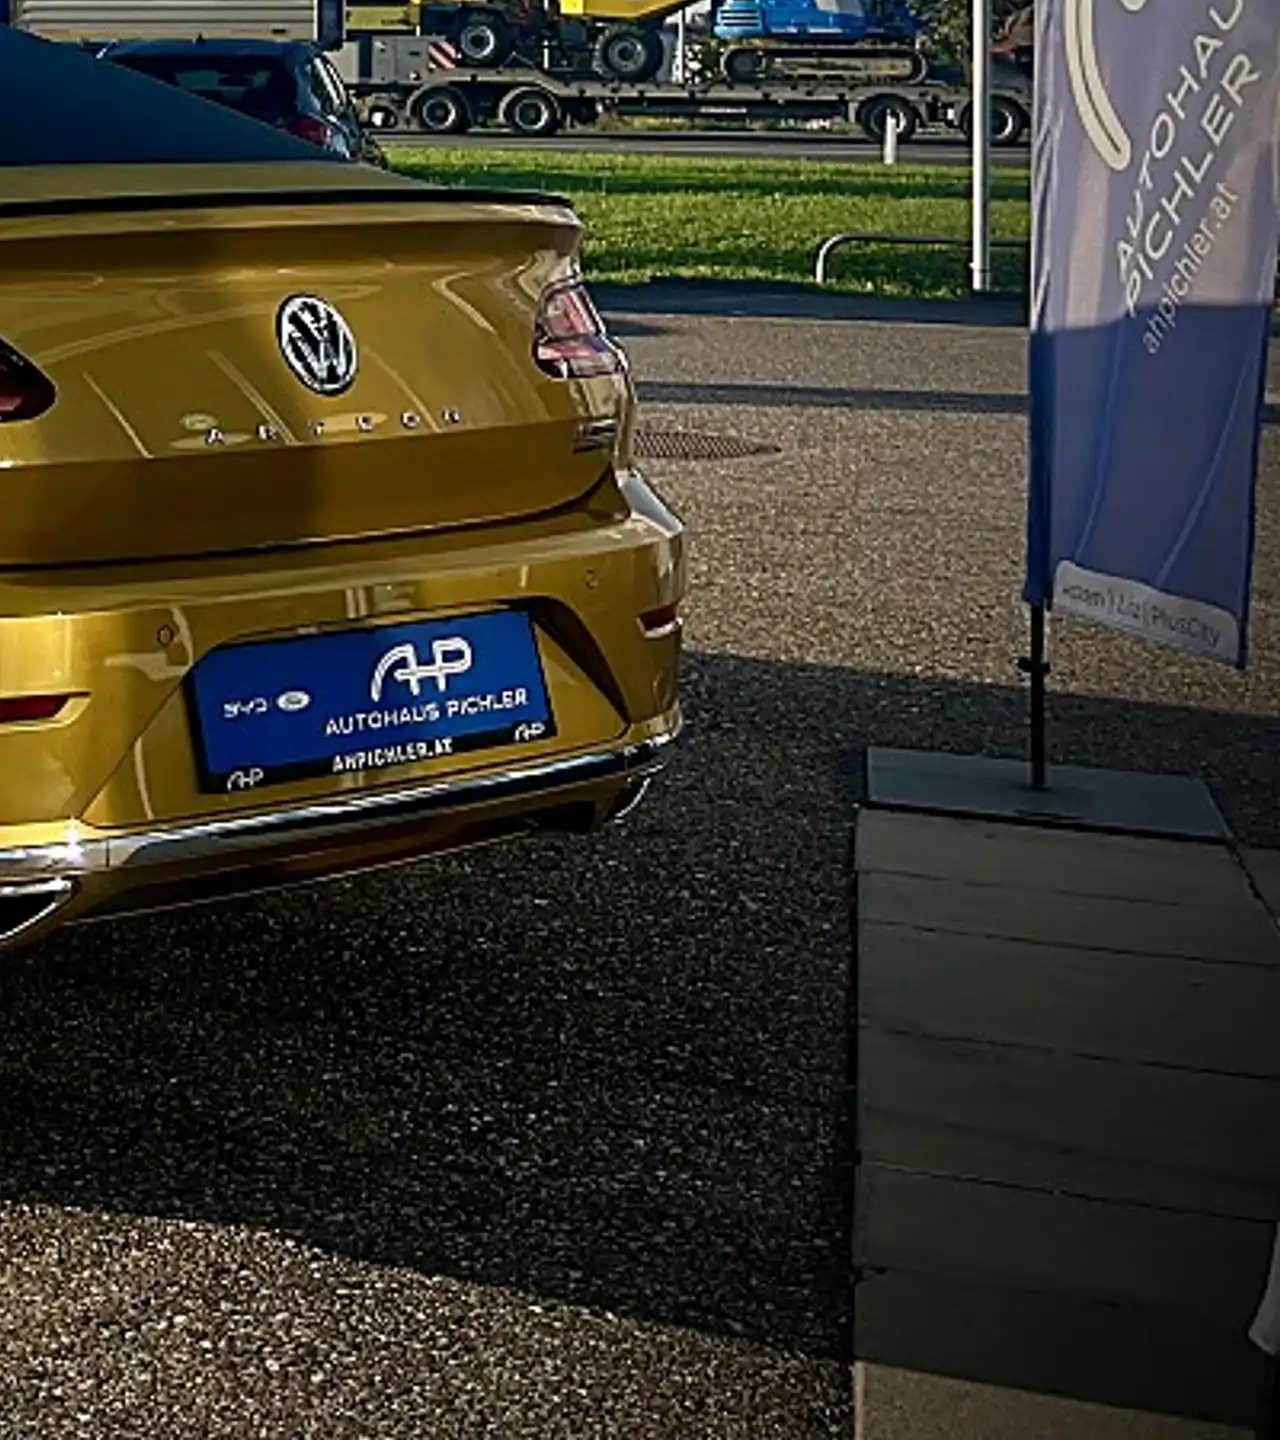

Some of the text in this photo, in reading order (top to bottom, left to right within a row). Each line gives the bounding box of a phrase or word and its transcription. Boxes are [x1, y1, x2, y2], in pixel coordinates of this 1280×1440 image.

[1124, 53, 1260, 318] PICHLER
[1142, 179, 1240, 355] ahpichler.at
[325, 701, 440, 737] AUTOHAUS
[446, 687, 529, 719] PICHLER
